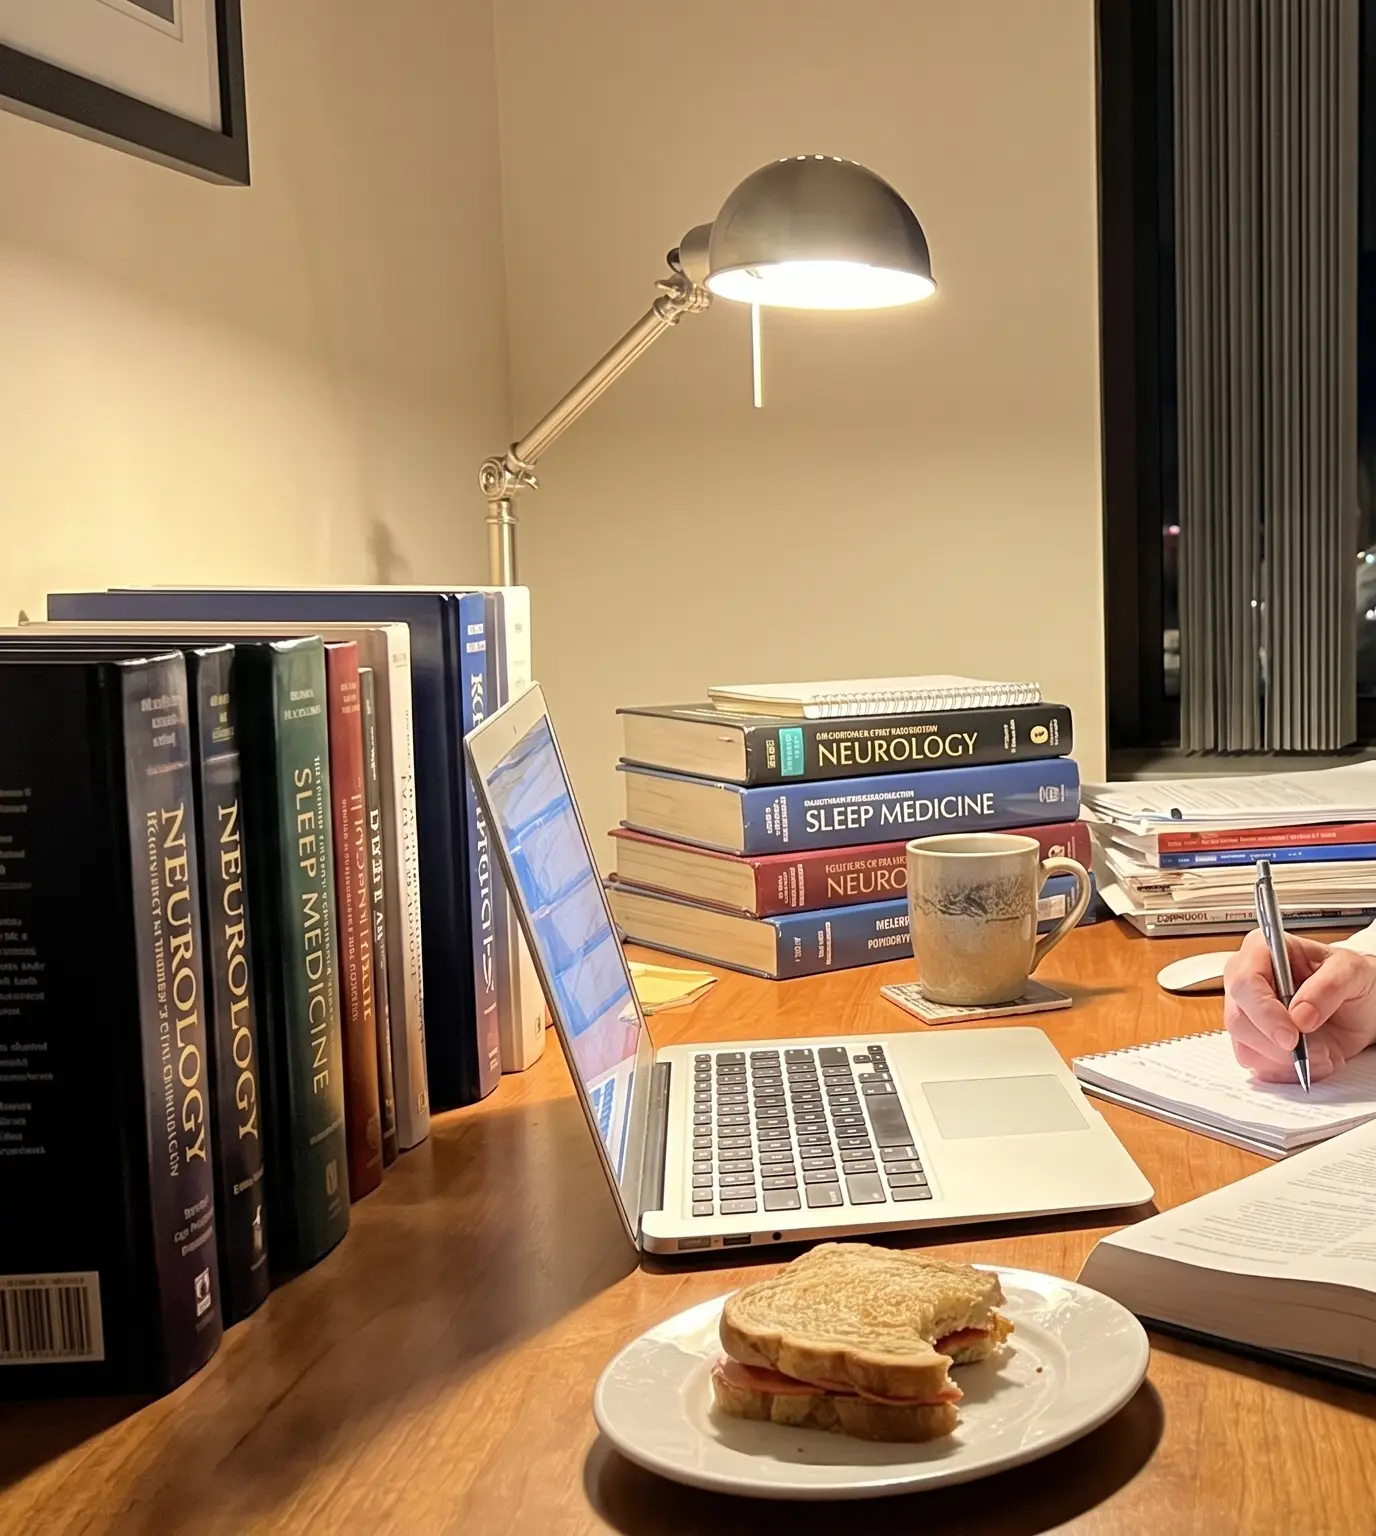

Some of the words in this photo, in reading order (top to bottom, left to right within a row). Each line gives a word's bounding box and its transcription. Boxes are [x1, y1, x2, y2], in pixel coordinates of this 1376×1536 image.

[294, 767, 317, 880] SLEEP
[805, 805, 874, 833] SLEEP
[880, 792, 995, 825] MEDICINE
[819, 732, 978, 767] NEUROLOGY
[160, 802, 207, 1163] NEUROLOGY
[217, 799, 259, 1141] NEUROLOGY
[302, 890, 330, 1095] MEDICINE
